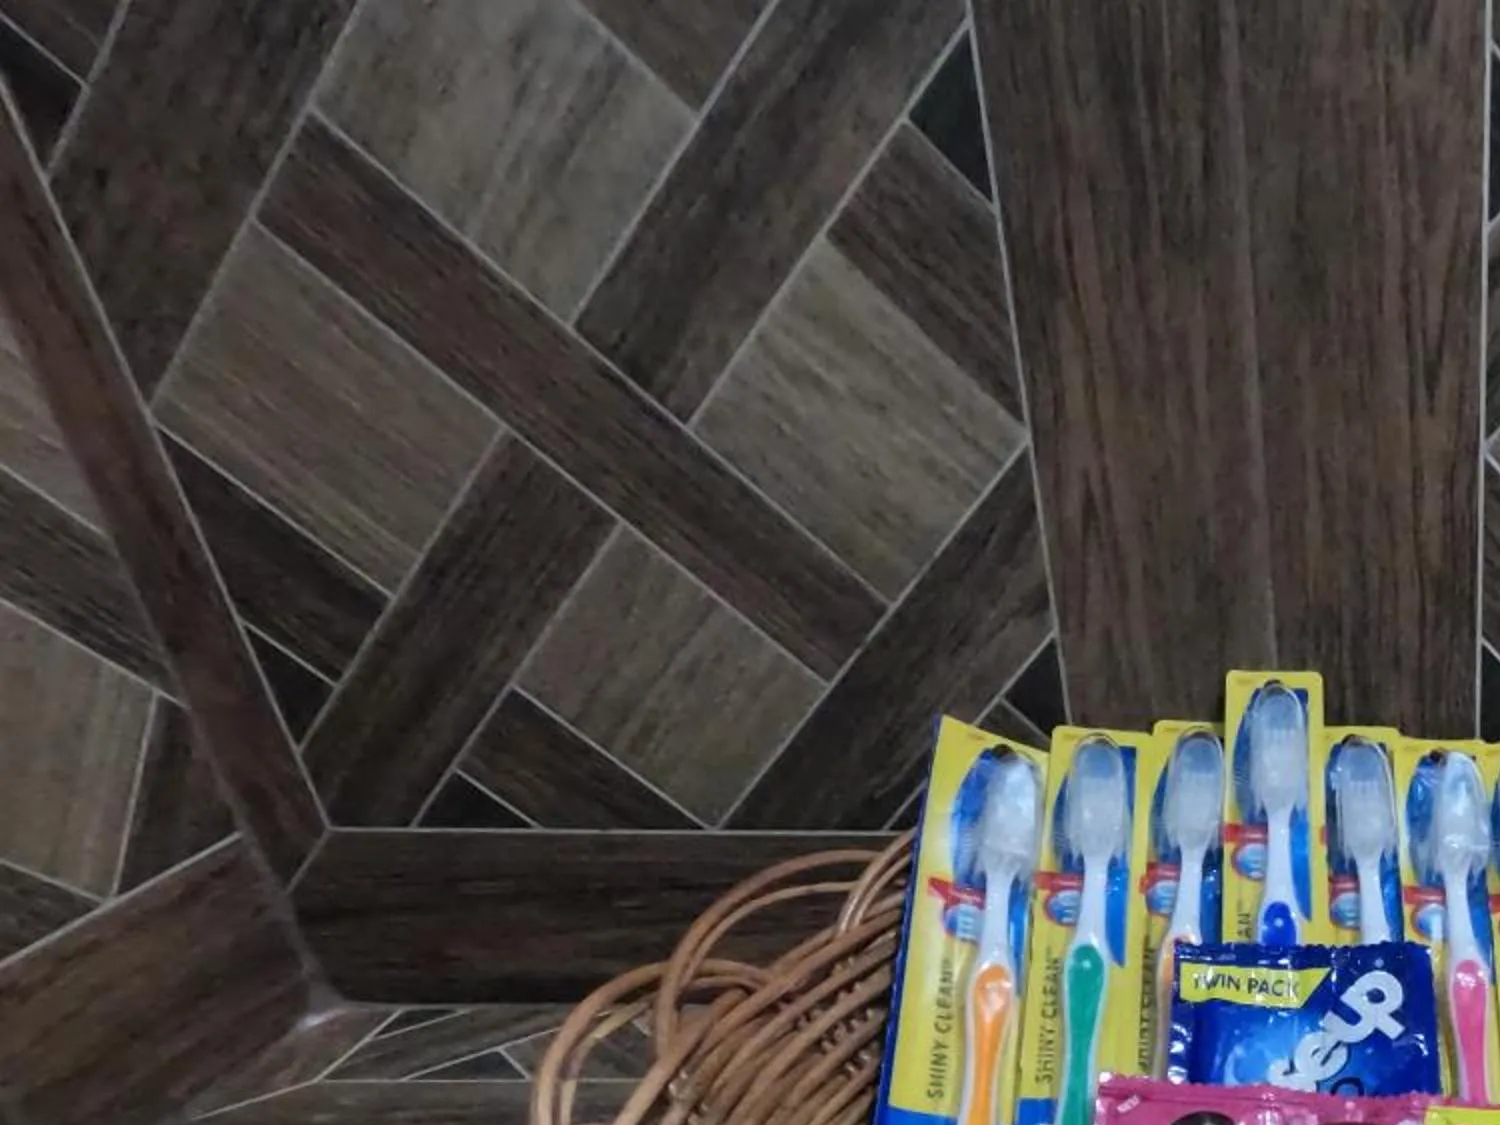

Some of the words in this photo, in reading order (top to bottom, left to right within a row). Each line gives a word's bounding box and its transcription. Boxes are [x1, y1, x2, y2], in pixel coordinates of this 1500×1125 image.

[1041, 956, 1061, 1019] CLEAN
[1192, 969, 1243, 992] TWIN
[927, 1038, 949, 1100] SHINY
[1035, 1026, 1057, 1086] SHINY
